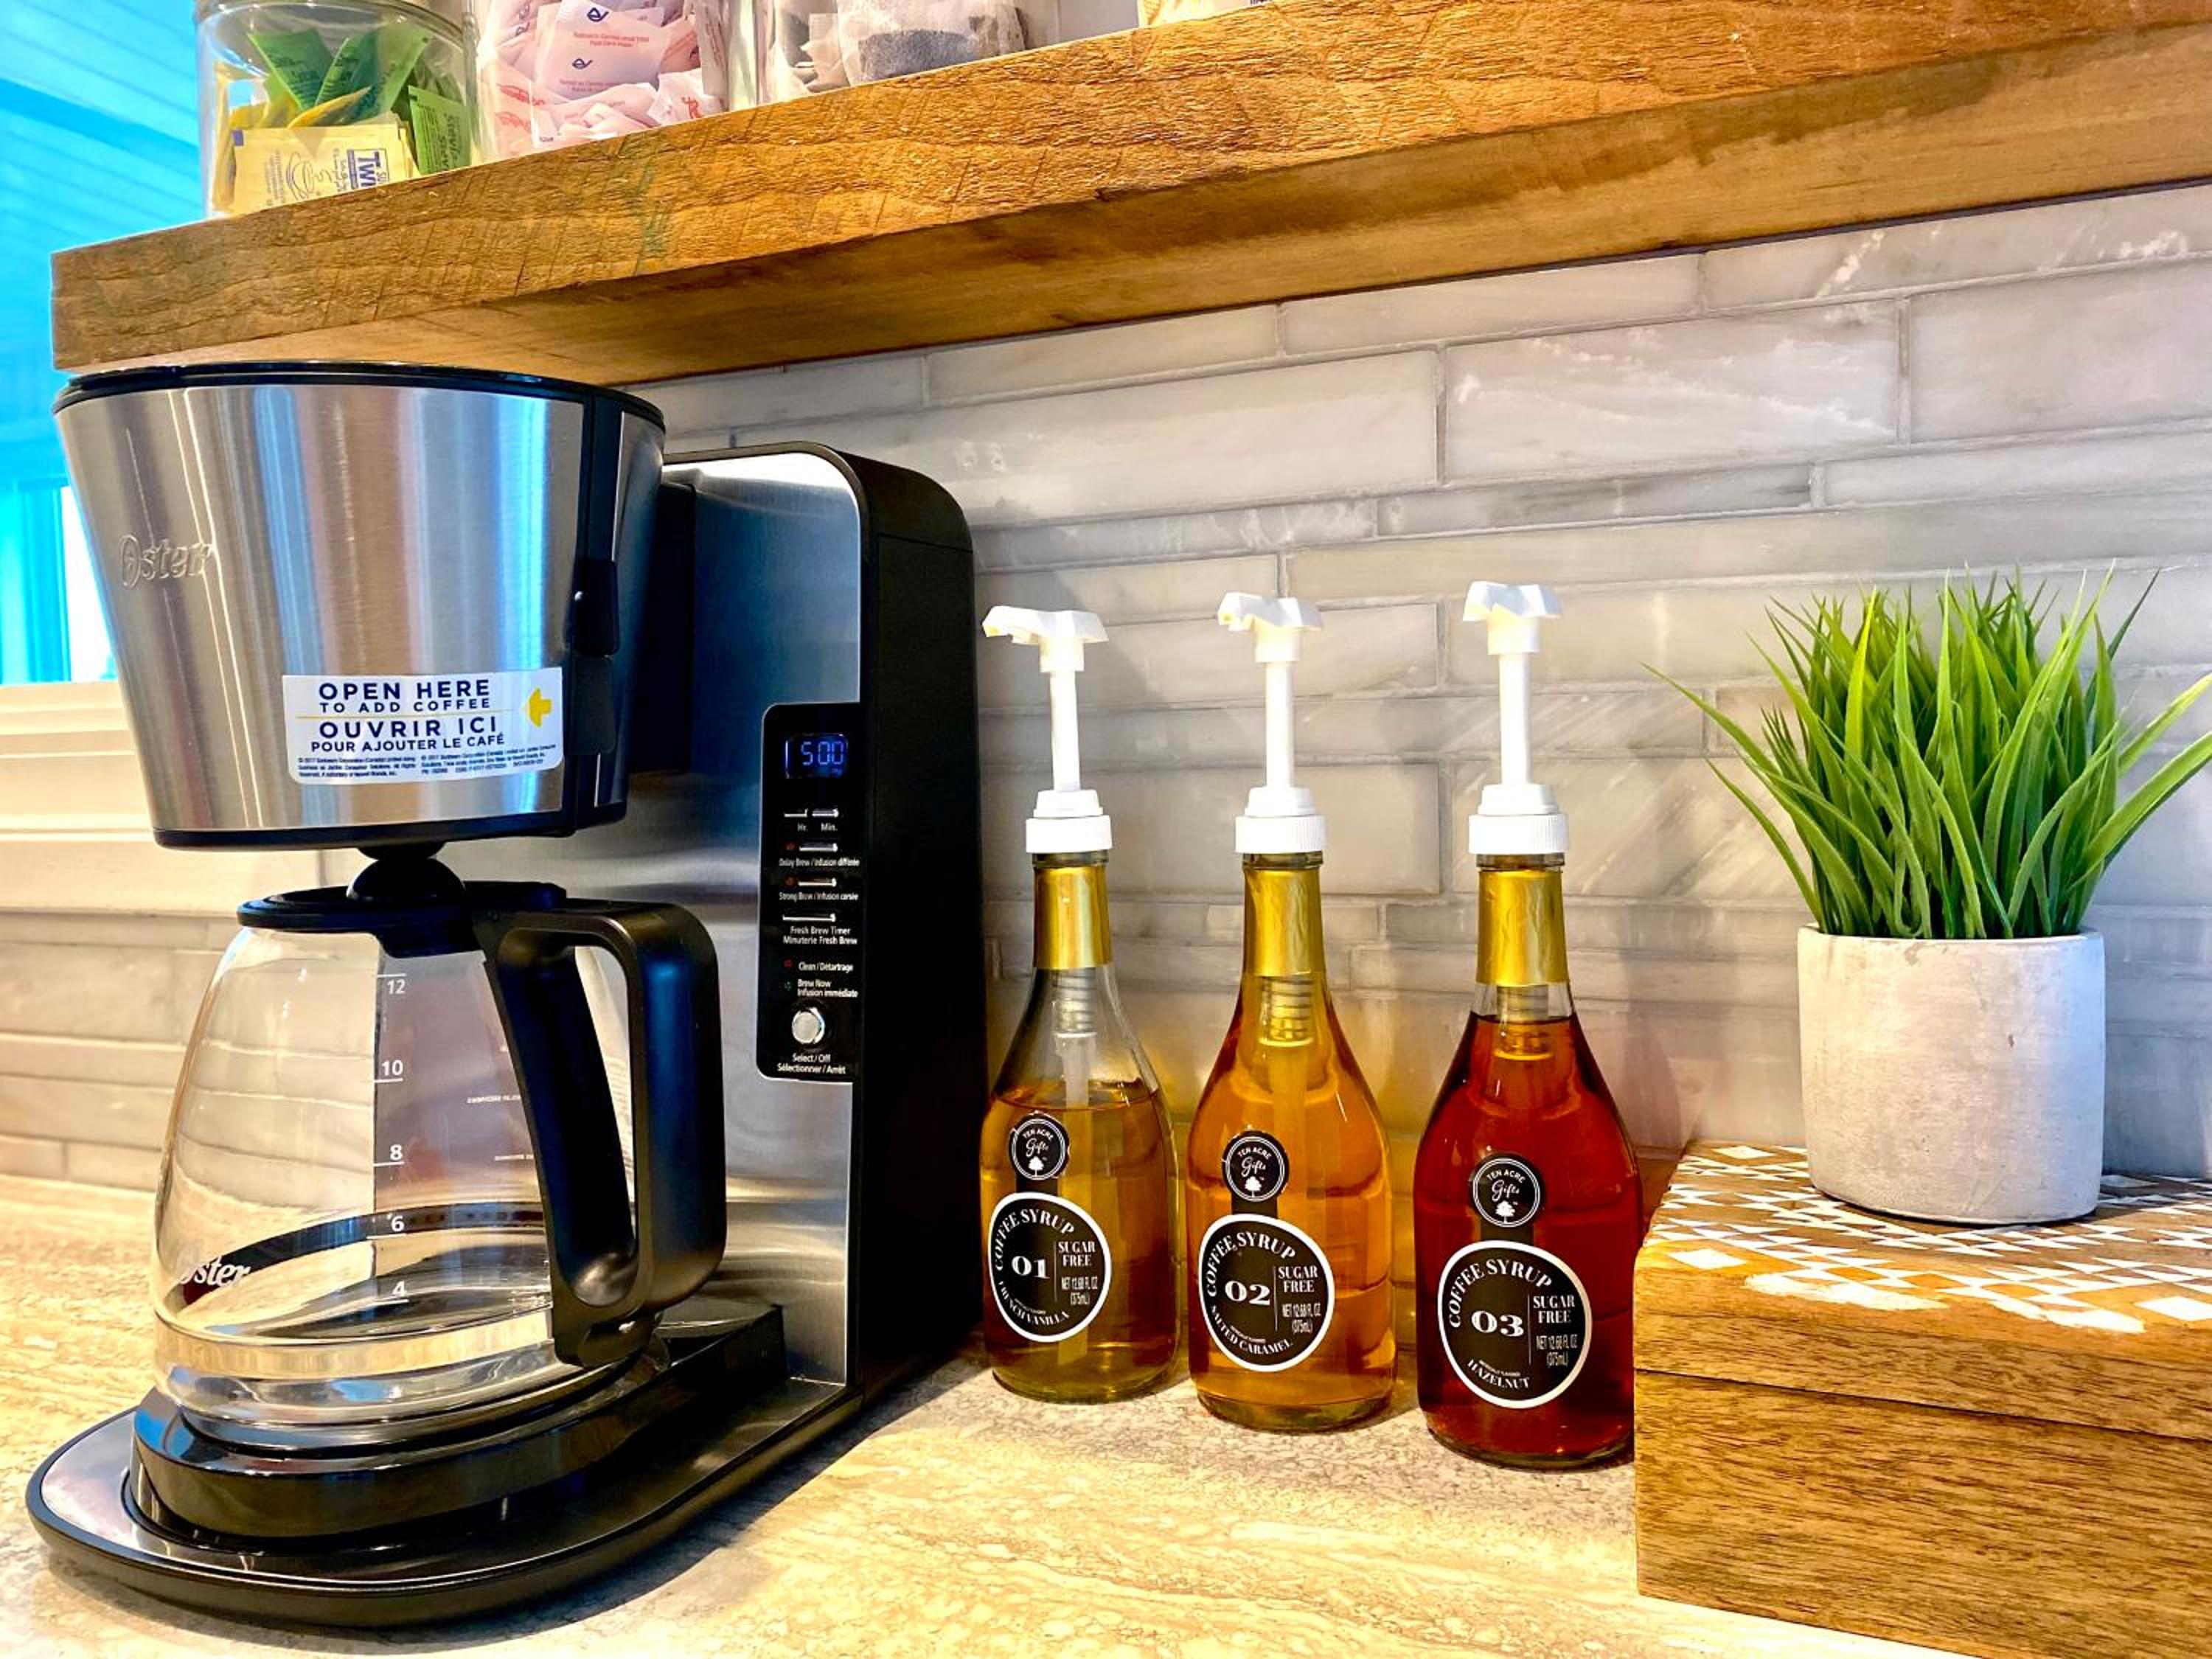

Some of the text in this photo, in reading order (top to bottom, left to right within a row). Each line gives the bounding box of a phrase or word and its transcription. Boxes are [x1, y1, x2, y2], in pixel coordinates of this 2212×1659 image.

[120, 534, 211, 589] Oster
[319, 679, 490, 700] OPEN HERE
[320, 698, 490, 713] TO ADD COFFEE
[319, 717, 496, 739] OUVRIR ICI
[311, 733, 504, 752] POUR AJOUTER LE CAFÉ
[821, 823, 838, 831] Min.
[790, 925, 850, 935] Fresh Brew Timer
[783, 936, 858, 945] Minuterie Fresh Brew
[799, 961, 816, 970] Clean
[387, 978, 406, 995] 12
[798, 978, 832, 987] Brew Now
[798, 988, 824, 996] Infusion
[793, 1053, 814, 1062] Select
[818, 1054, 831, 1062] Off
[382, 1060, 403, 1076] 10
[1022, 1129, 1054, 1142] TEN ACRE
[389, 1144, 403, 1161] 8
[1026, 1138, 1049, 1158] Gifts
[1237, 1147, 1272, 1161] TEN ACRE
[1241, 1156, 1267, 1178] Gifts
[1486, 1169, 1526, 1183] TEN ACRE
[1491, 1180, 1520, 1202] Gifts
[391, 1216, 405, 1232] 6
[995, 1208, 1075, 1271] COFFEE SYRUP
[1058, 1241, 1096, 1253] SUGAR
[1011, 1255, 1050, 1279] 01
[1062, 1254, 1092, 1267] FREE
[1206, 1232, 1295, 1298] COFFEE SYRUP
[1278, 1265, 1318, 1279] SUGAR
[392, 1281, 407, 1297] 4
[1224, 1280, 1271, 1306] 02
[1283, 1279, 1315, 1293] FREE
[1448, 1259, 1552, 1329] COFFEE SYRUP
[998, 1281, 1026, 1320] FRENCH
[1026, 1311, 1070, 1326] VANILLA
[1533, 1295, 1575, 1309] SUGAR
[1282, 1303, 1293, 1318] NET
[1538, 1310, 1571, 1324] FREE
[1211, 1305, 1239, 1345] SALTED
[1239, 1338, 1293, 1354] CARAMEL
[1471, 1310, 1524, 1338] 03
[1536, 1335, 1548, 1350] NET
[1467, 1359, 1531, 1389] HAZELNUT
